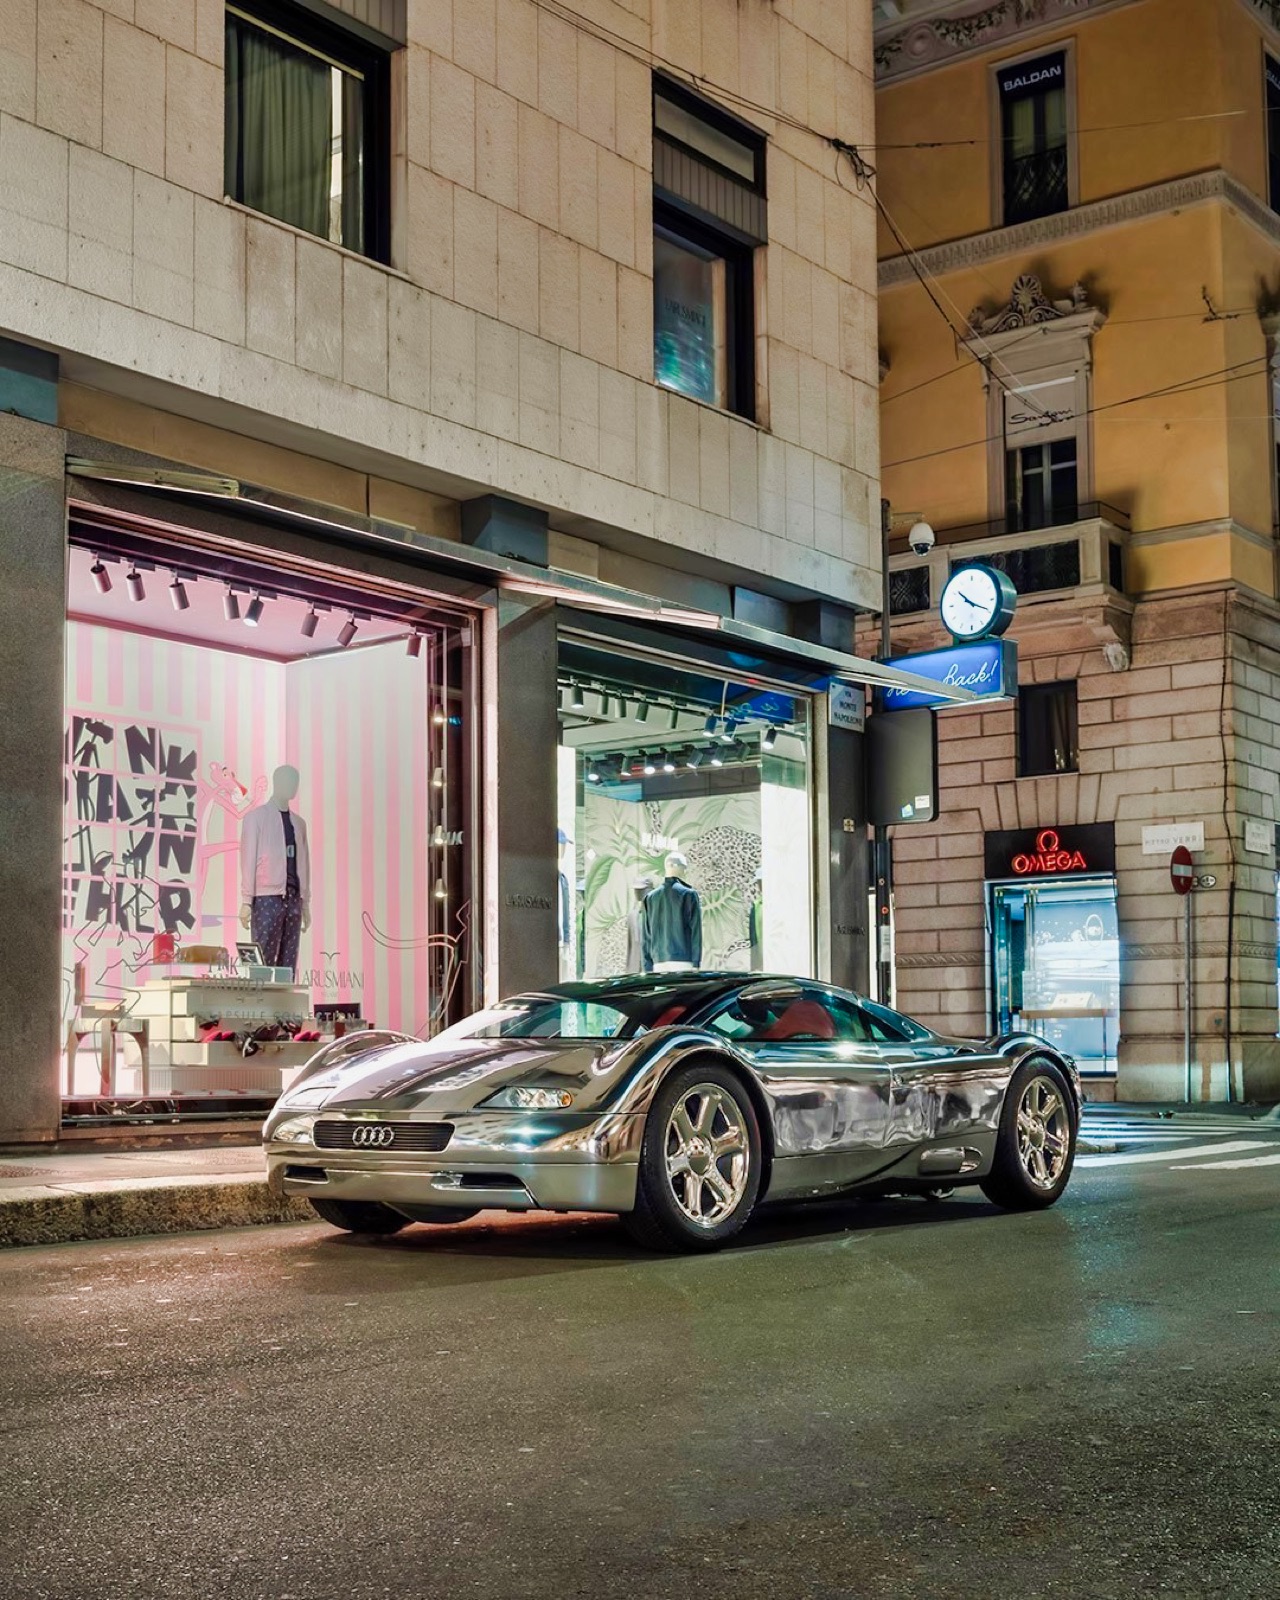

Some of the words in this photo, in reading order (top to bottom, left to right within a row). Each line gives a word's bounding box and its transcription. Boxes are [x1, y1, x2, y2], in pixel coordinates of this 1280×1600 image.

[1004, 65, 1062, 91] BALDAN
[943, 659, 999, 686] Back!
[1011, 851, 1087, 874] OMEGA
